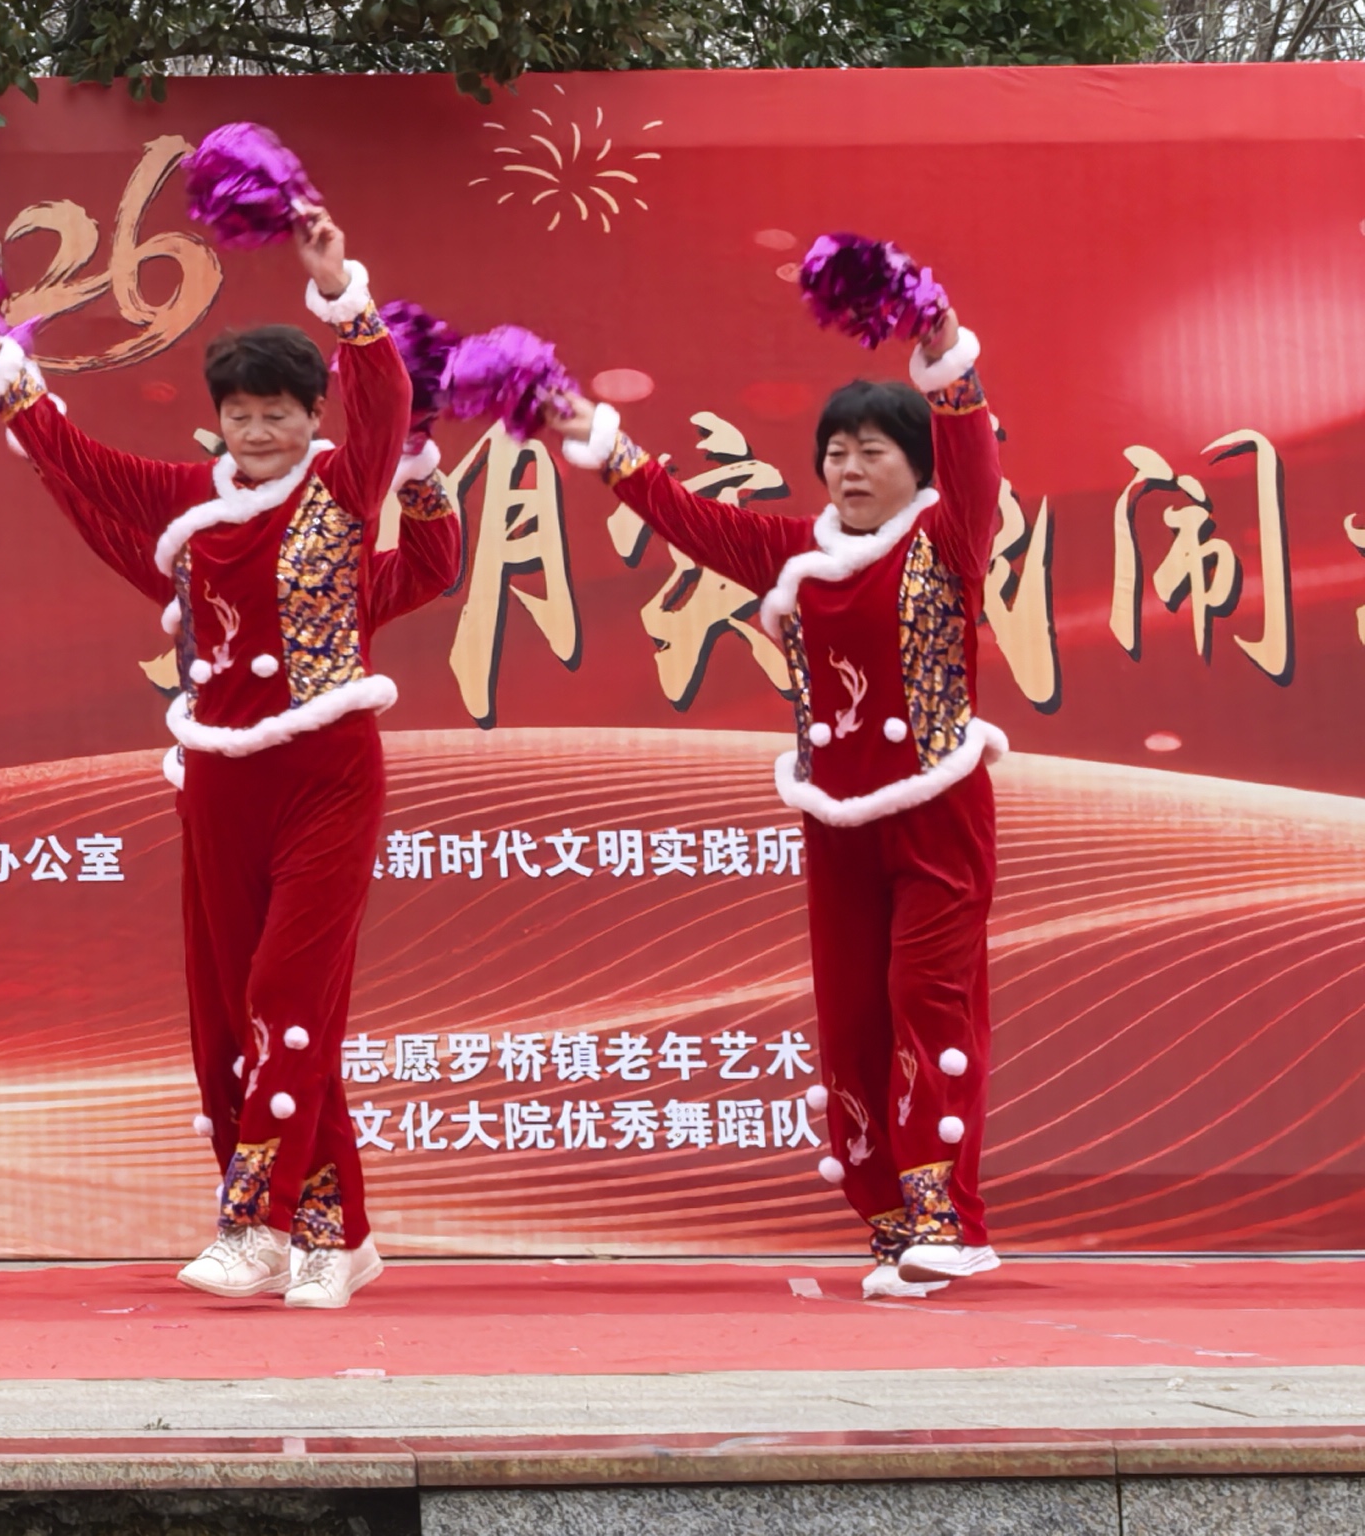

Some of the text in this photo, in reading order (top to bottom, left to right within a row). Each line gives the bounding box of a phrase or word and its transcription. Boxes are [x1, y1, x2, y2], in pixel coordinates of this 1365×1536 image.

[372, 826, 804, 880] 新时代文明实践所
